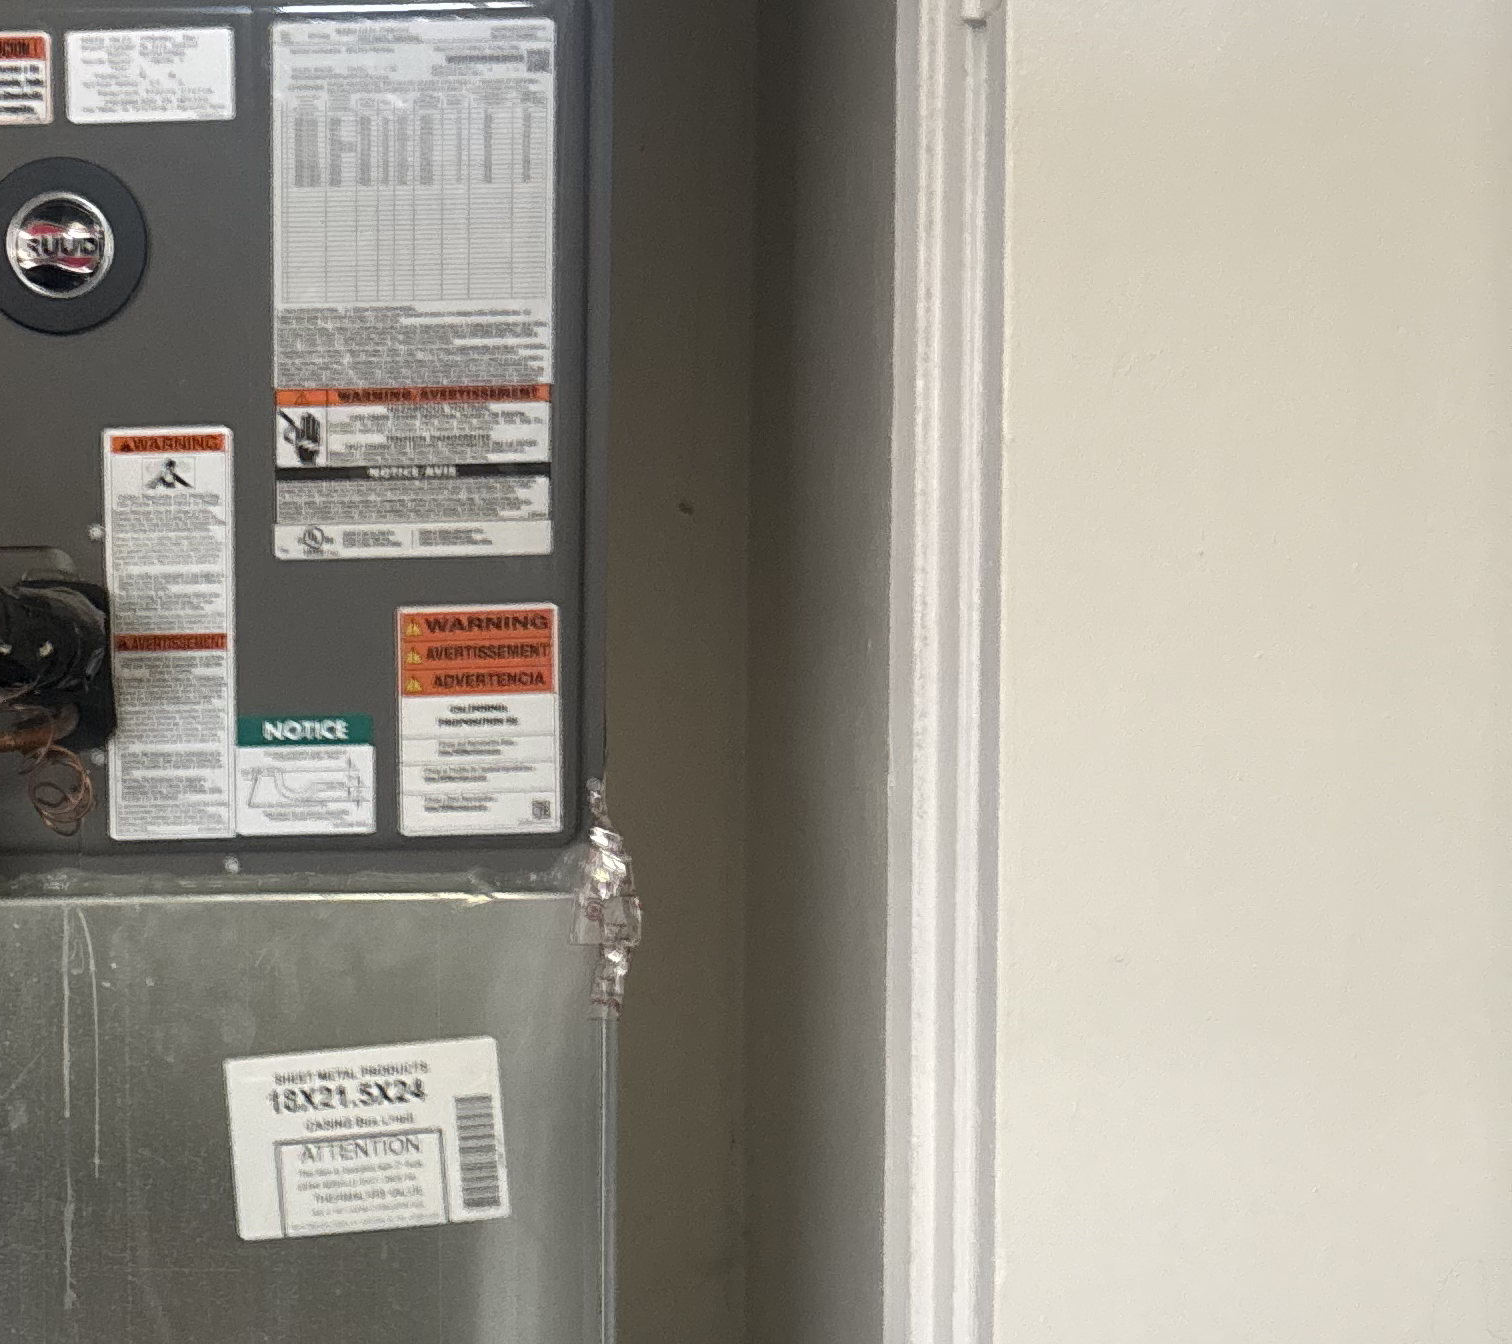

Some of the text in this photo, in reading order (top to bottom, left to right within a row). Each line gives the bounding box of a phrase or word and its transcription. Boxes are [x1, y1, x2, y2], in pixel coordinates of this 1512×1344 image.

[27, 236, 99, 259] RUUD
[131, 434, 220, 452] WARNING
[425, 615, 549, 634] WARNING
[426, 642, 551, 661] AVERTISSEMENT
[432, 671, 546, 689] ADVERTENCIA
[261, 717, 350, 742] NOTICE
[299, 1134, 423, 1165] ATTENTION
